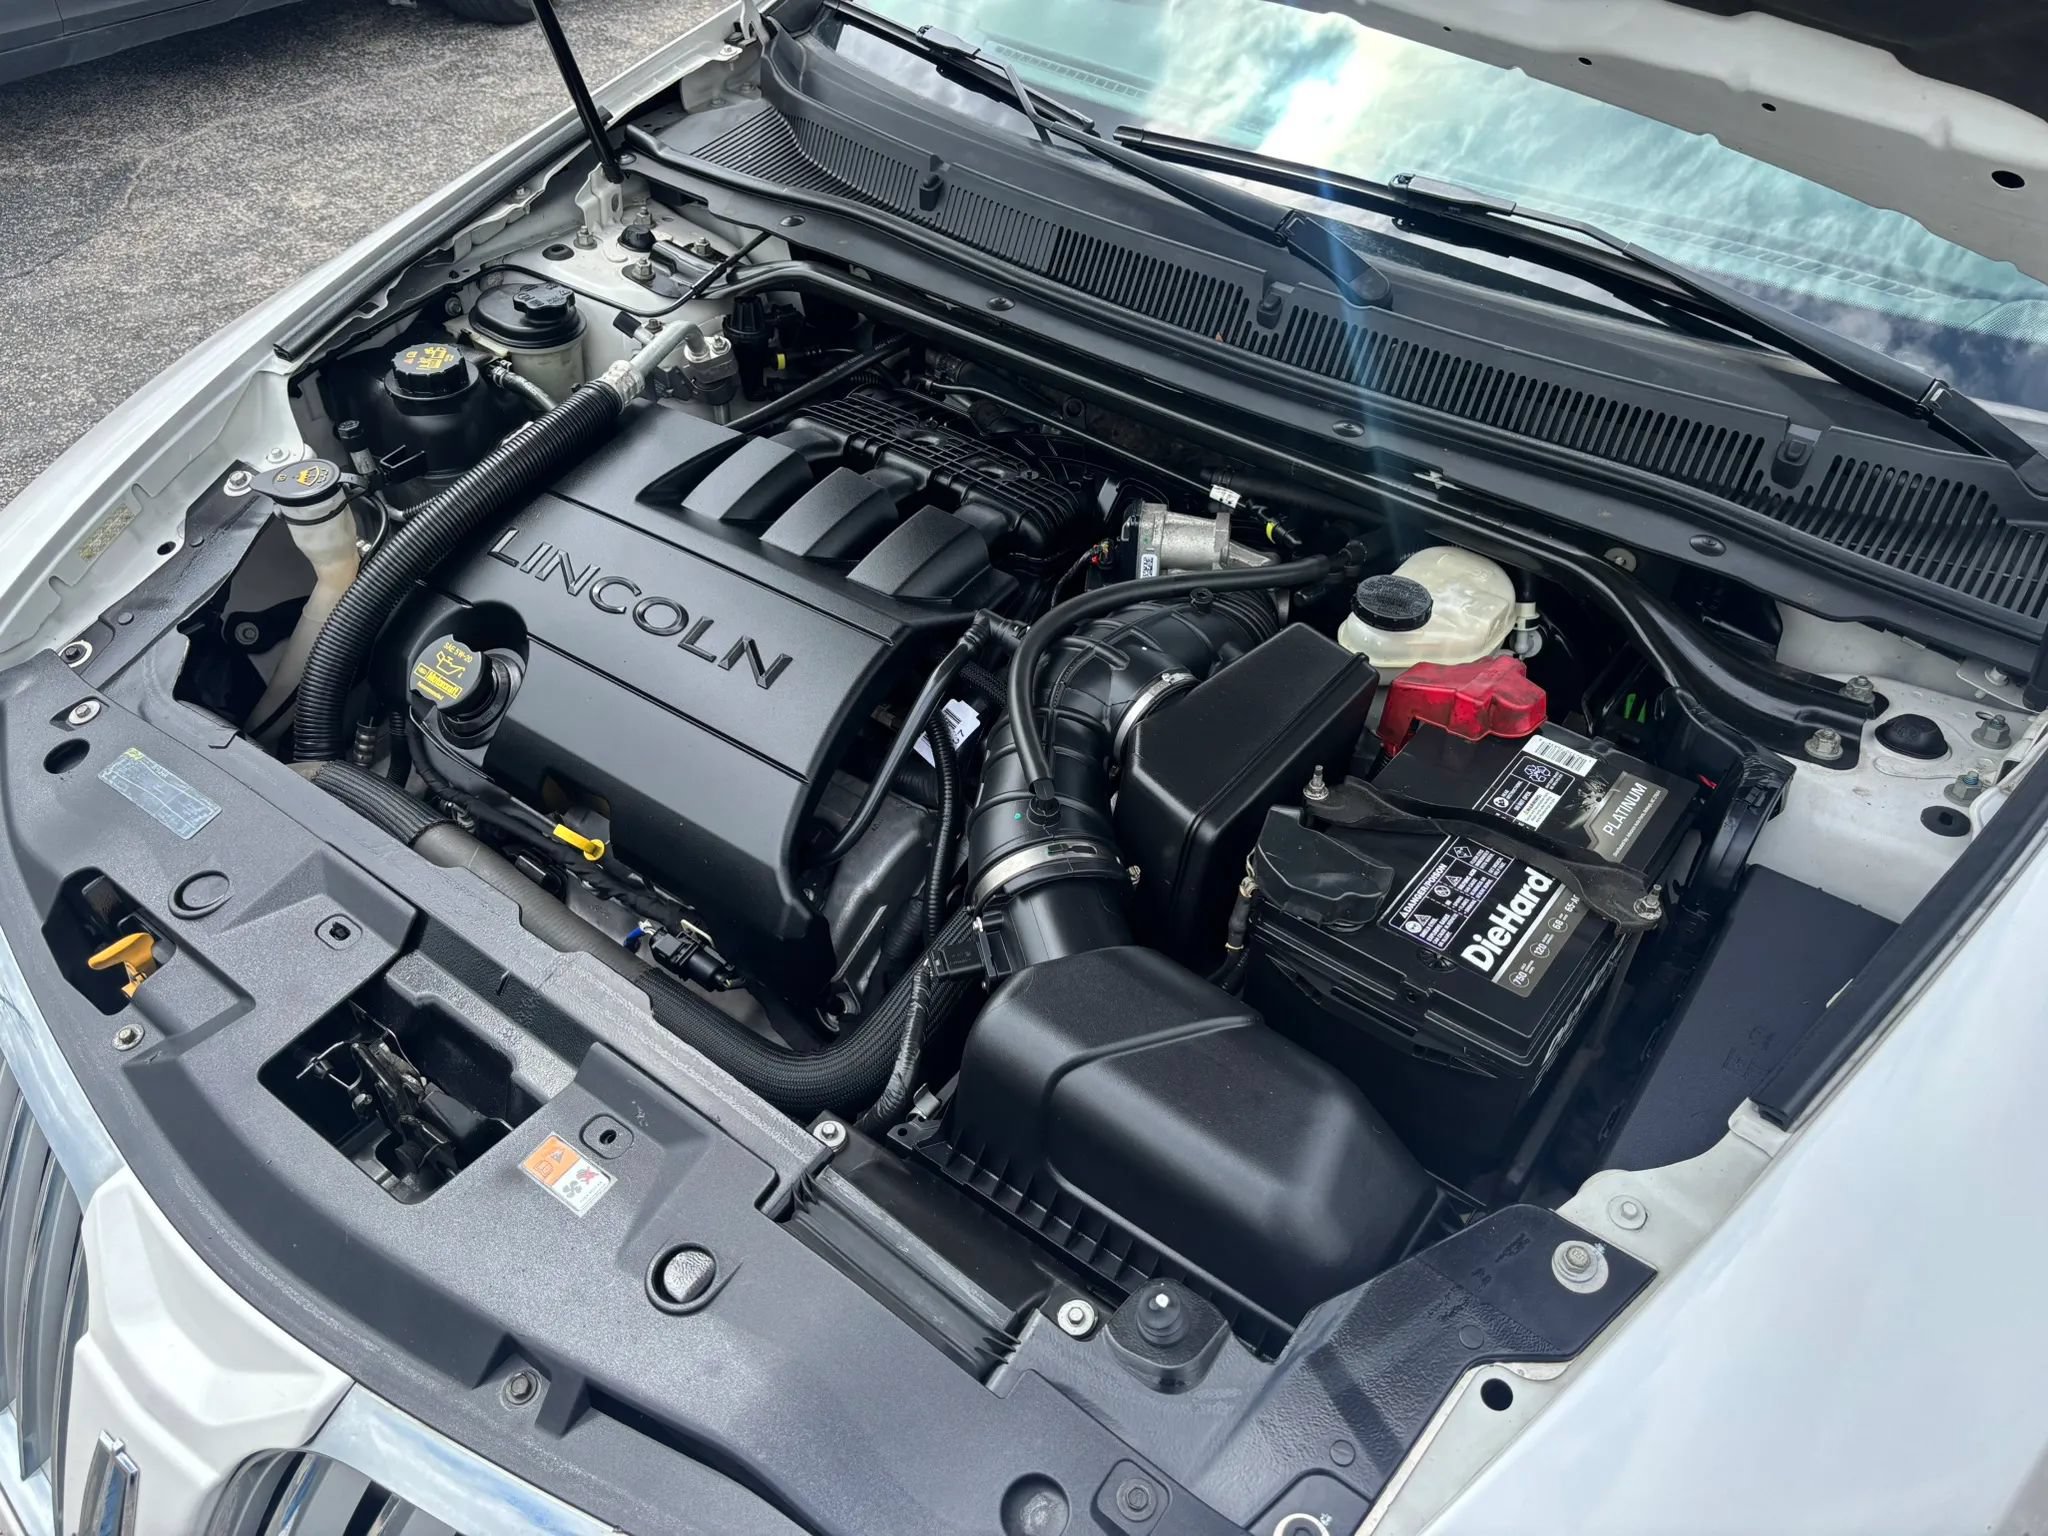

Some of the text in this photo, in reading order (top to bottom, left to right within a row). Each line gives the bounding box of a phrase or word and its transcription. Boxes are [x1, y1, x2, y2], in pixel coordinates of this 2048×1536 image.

[488, 529, 793, 690] LINCOLN
[1602, 782, 1648, 835] PLATINUM
[1402, 862, 1447, 913] DANGER/POISON
[1458, 865, 1555, 972] DieHard
[1512, 970, 1528, 985] 750
[1533, 942, 1547, 956] 120
[1551, 918, 1564, 930] 68
